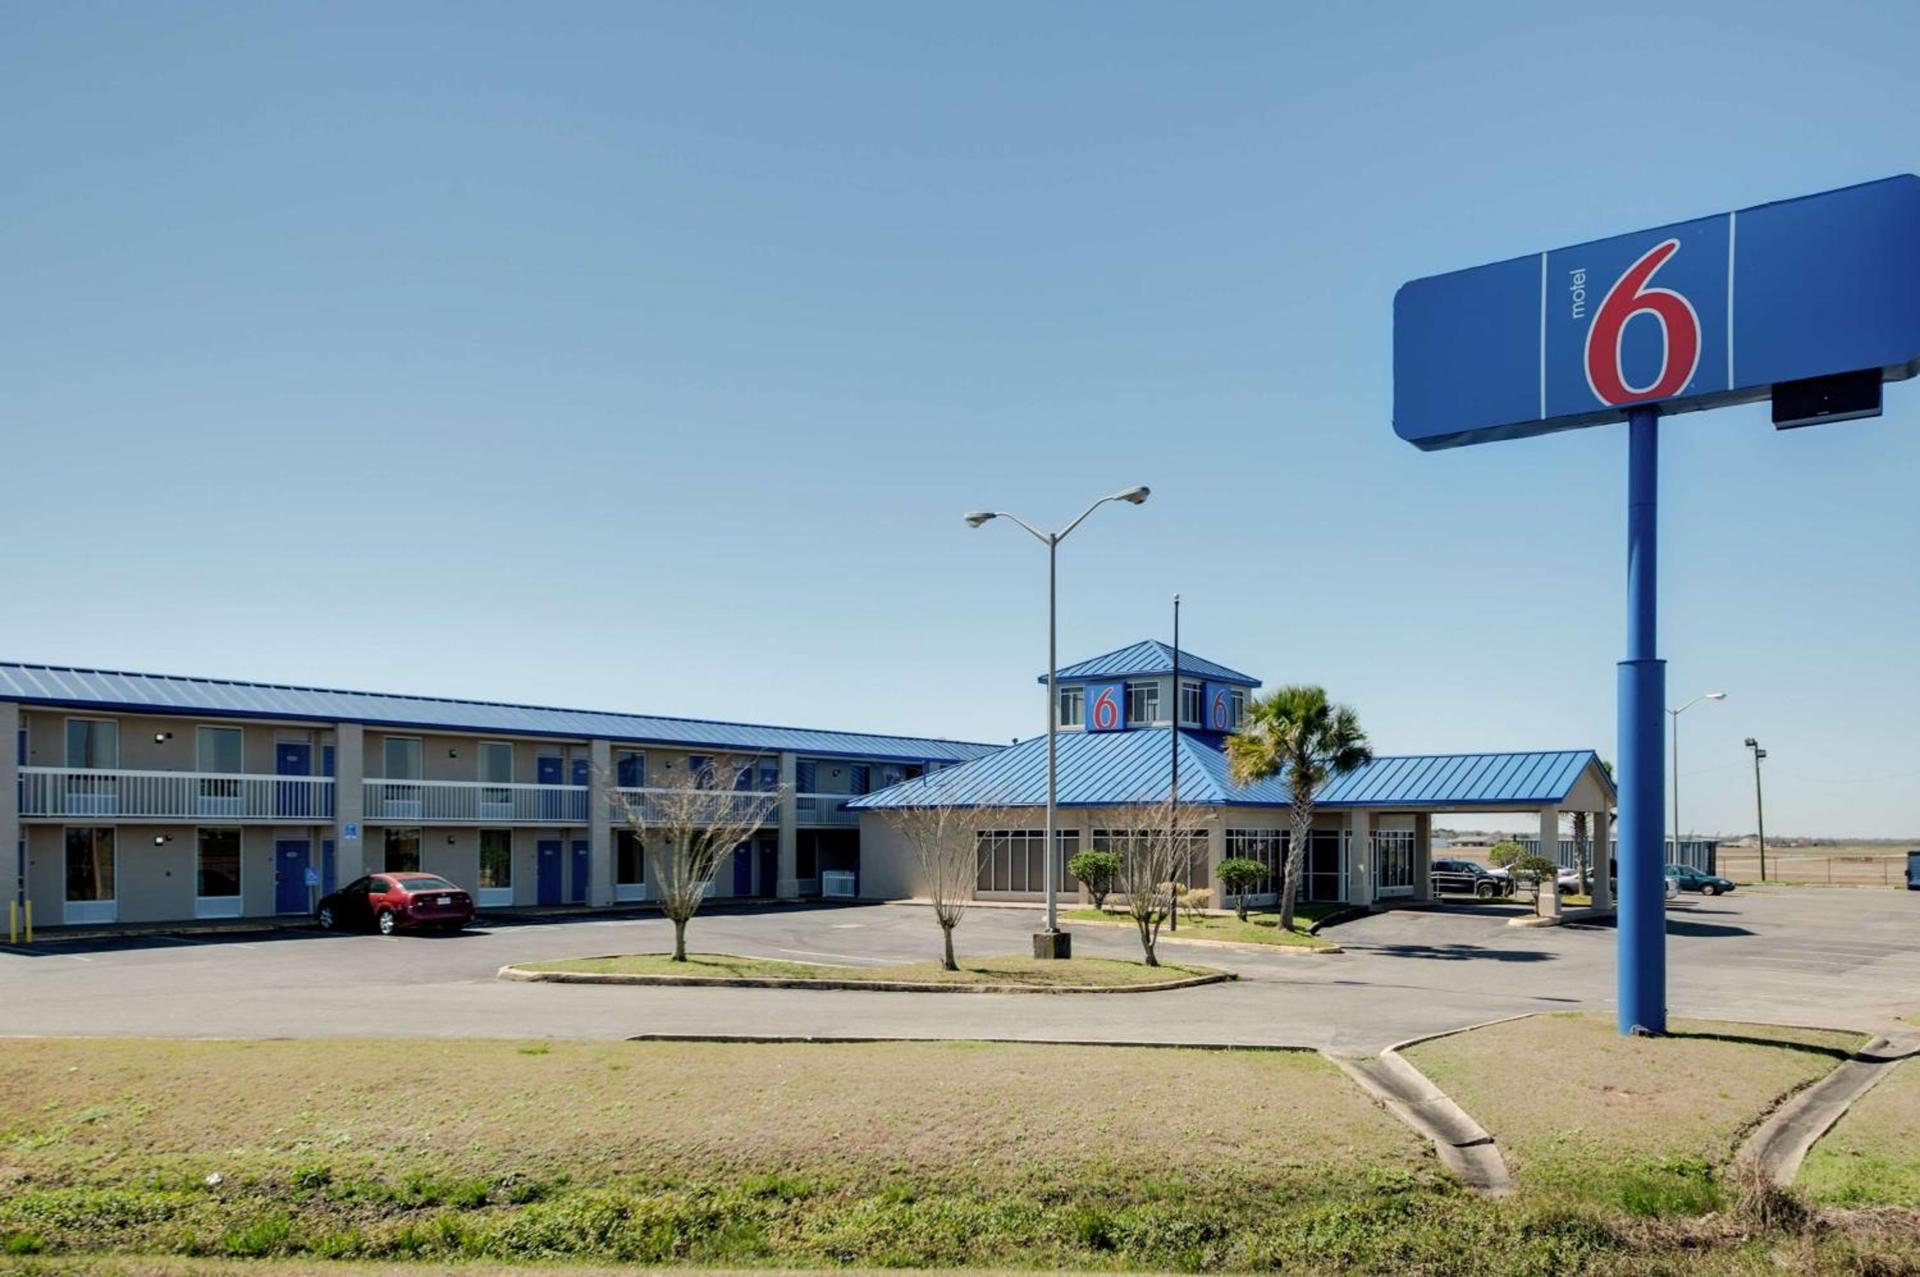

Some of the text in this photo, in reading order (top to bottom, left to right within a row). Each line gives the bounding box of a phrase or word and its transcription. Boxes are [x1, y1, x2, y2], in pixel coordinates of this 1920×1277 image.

[1569, 267, 1587, 319] motel
[1583, 238, 1702, 407] 6
[1093, 686, 1118, 731] 6
[1213, 688, 1229, 730] 6
